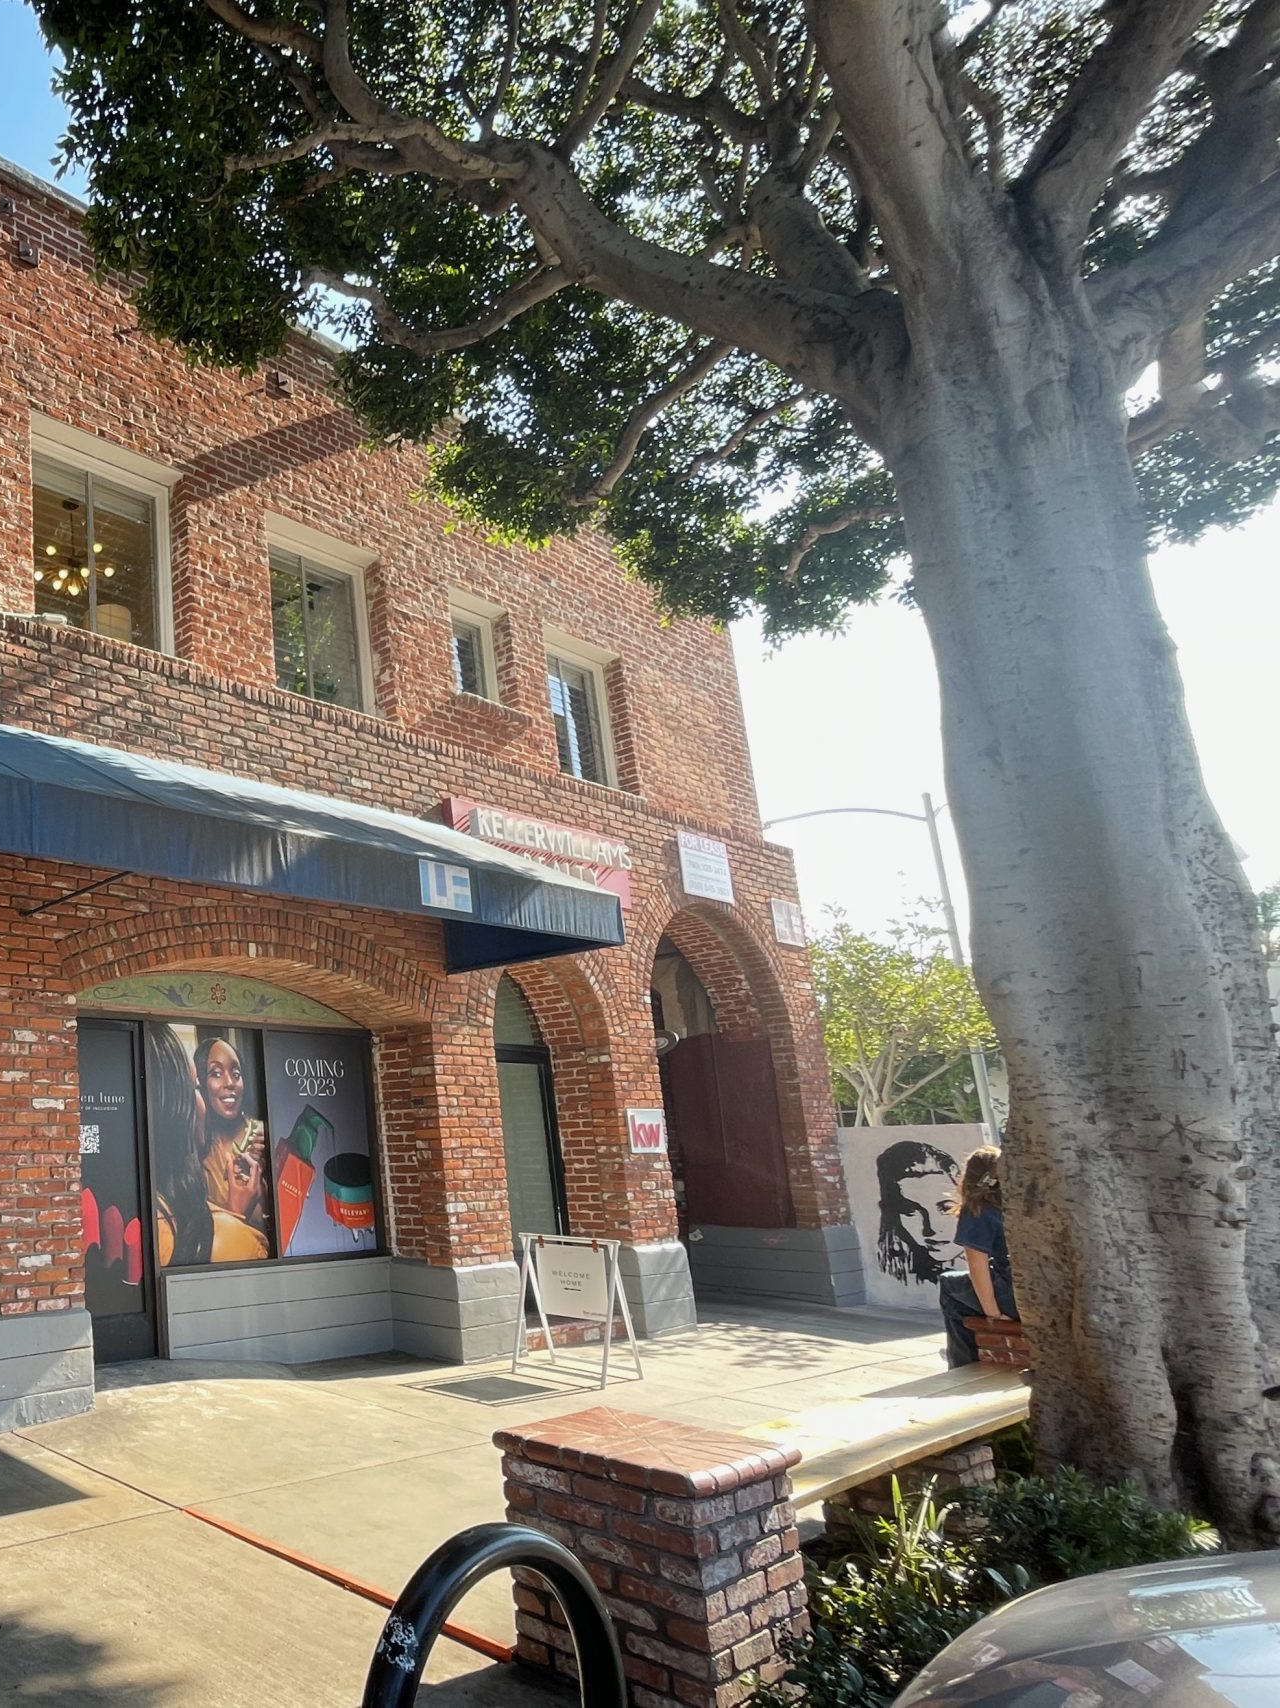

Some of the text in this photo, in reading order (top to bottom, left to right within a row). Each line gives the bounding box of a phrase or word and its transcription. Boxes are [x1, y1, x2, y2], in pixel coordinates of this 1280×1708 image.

[680, 832, 698, 851] FOR
[699, 837, 726, 858] LEASE
[284, 1058, 344, 1078] COMING
[297, 1077, 336, 1097] 2023
[99, 1091, 125, 1104] lune
[630, 1114, 660, 1148] kw
[551, 1269, 591, 1280] WELCOME
[560, 1279, 583, 1287] HOME
